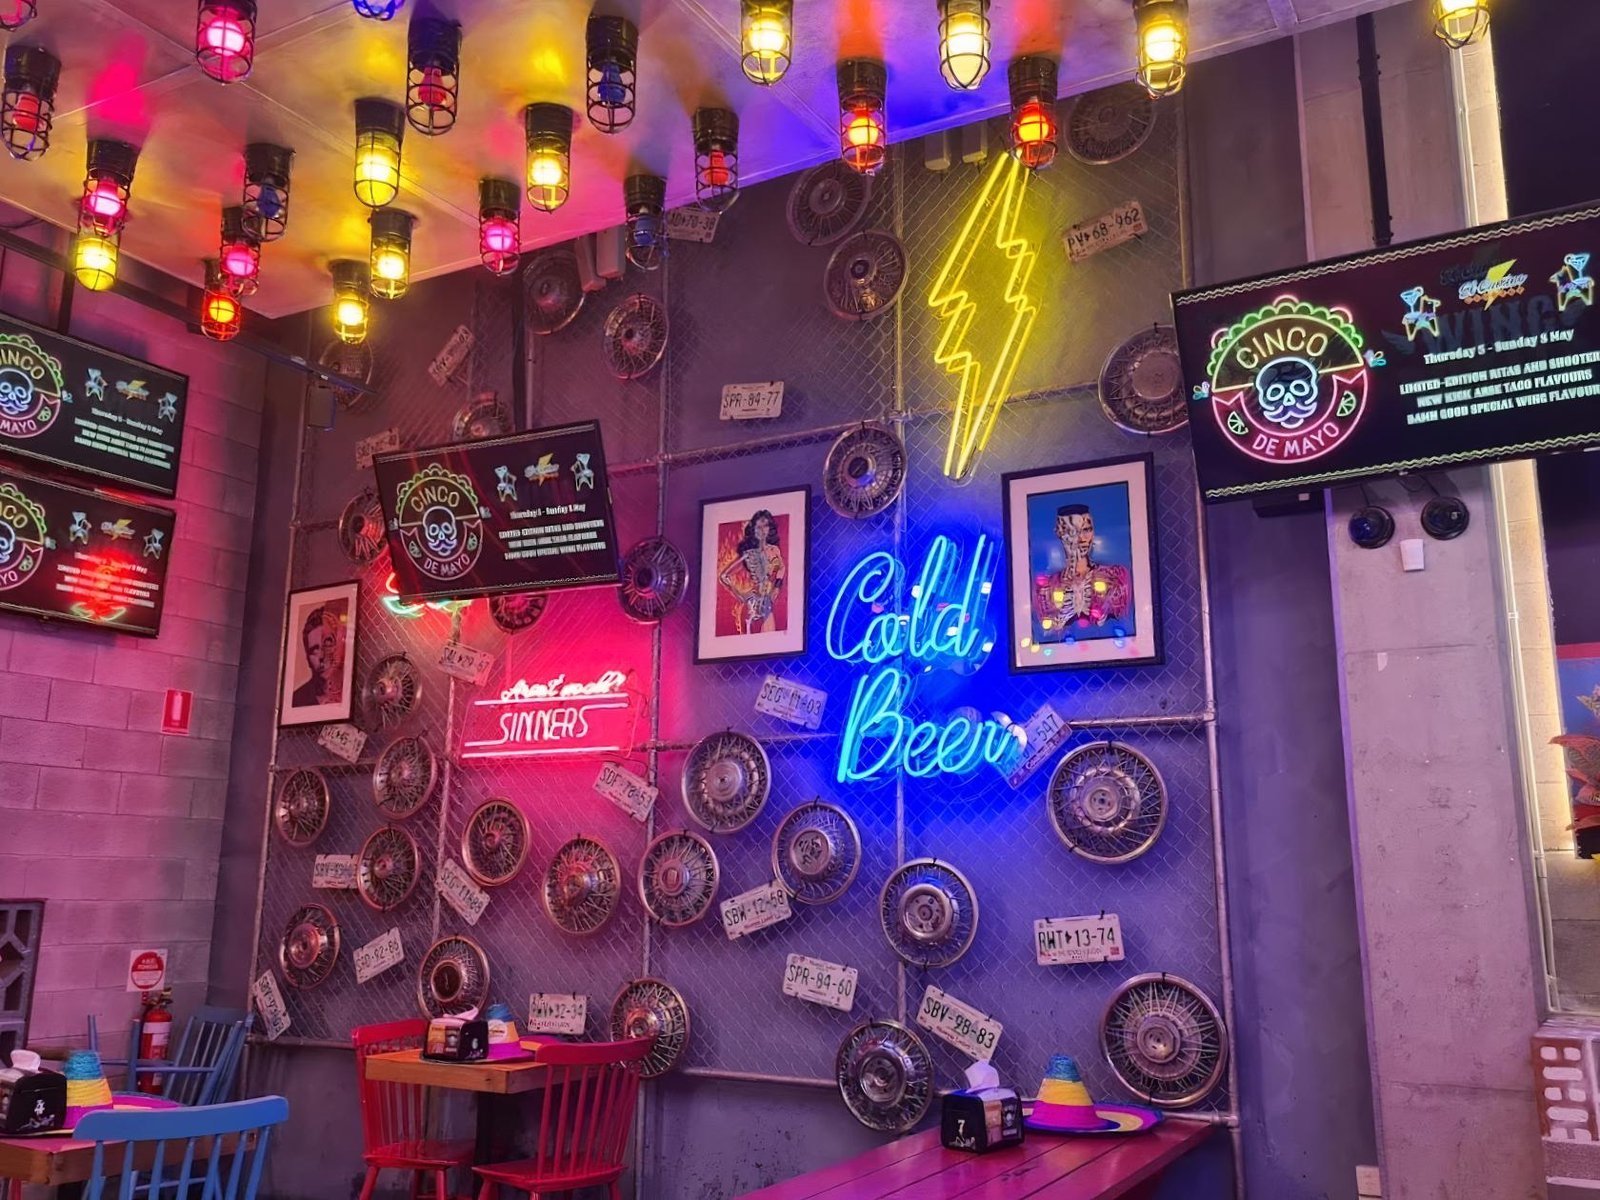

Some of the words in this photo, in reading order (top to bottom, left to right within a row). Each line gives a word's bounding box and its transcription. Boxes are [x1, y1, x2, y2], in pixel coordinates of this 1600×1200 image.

[0, 349, 45, 379] INCO
[1236, 326, 1328, 369] CINCO
[1423, 346, 1476, 365] Thursday
[1494, 335, 1538, 353] Sunday
[1549, 329, 1575, 343] May
[1503, 378, 1533, 393] TACO
[1534, 368, 1592, 388] FLAVOURS
[1523, 360, 1548, 374] AND
[1407, 410, 1438, 425] DAMN
[1439, 405, 1469, 420] GOOD
[1470, 398, 1514, 415] SPECIAL
[1515, 392, 1548, 407] WING
[1252, 433, 1279, 456] DE
[1284, 422, 1339, 458] MAYO
[411, 485, 460, 512] CINCO
[423, 558, 439, 575] DE
[440, 553, 470, 576] MAYO
[826, 533, 986, 664] Cold
[500, 707, 589, 742] SINNERS
[837, 667, 1012, 784] Beer
[923, 996, 996, 1049] SBV-98-83
[957, 1119, 966, 1136] 7
